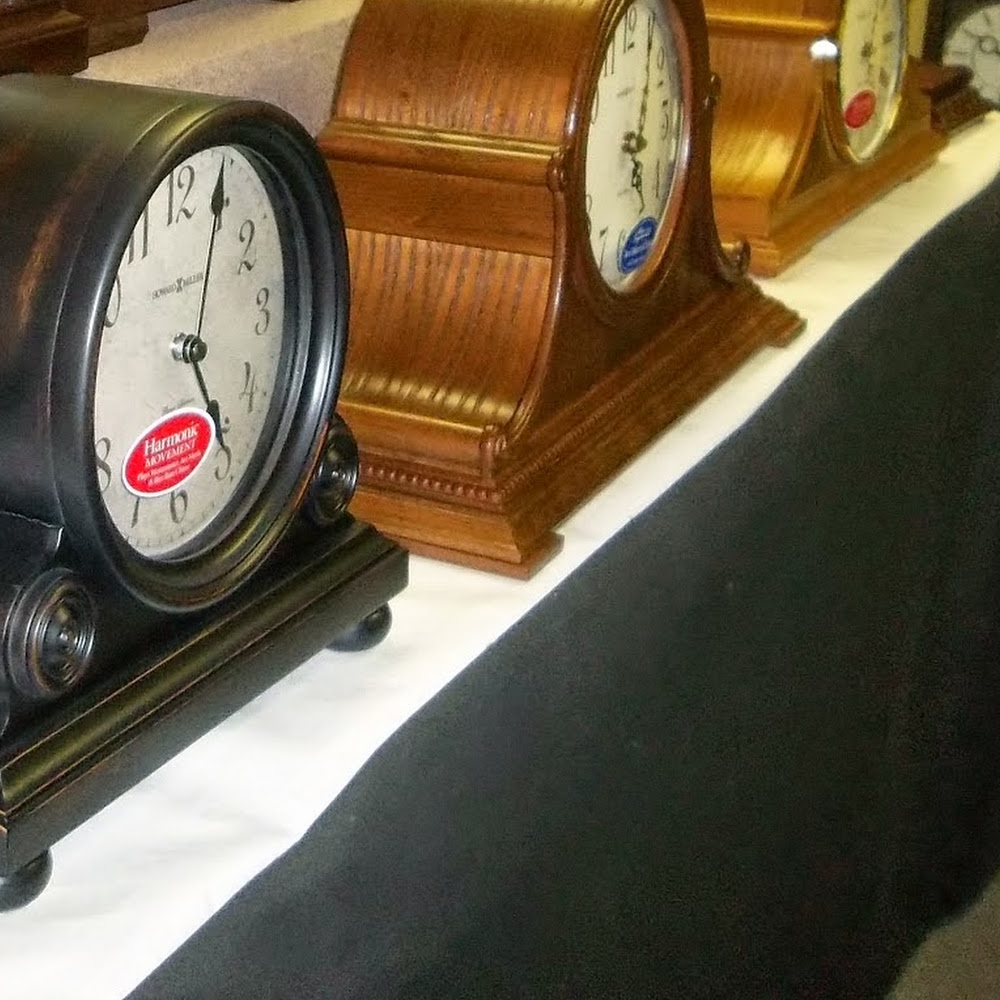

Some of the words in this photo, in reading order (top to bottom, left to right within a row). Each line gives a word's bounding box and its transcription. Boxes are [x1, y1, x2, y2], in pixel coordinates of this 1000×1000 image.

[166, 165, 196, 228] 12
[237, 219, 257, 276] 2
[254, 287, 270, 337] 3
[240, 361, 258, 414] 4
[143, 420, 200, 457] Harmonic
[144, 437, 197, 468] MOVEMENT
